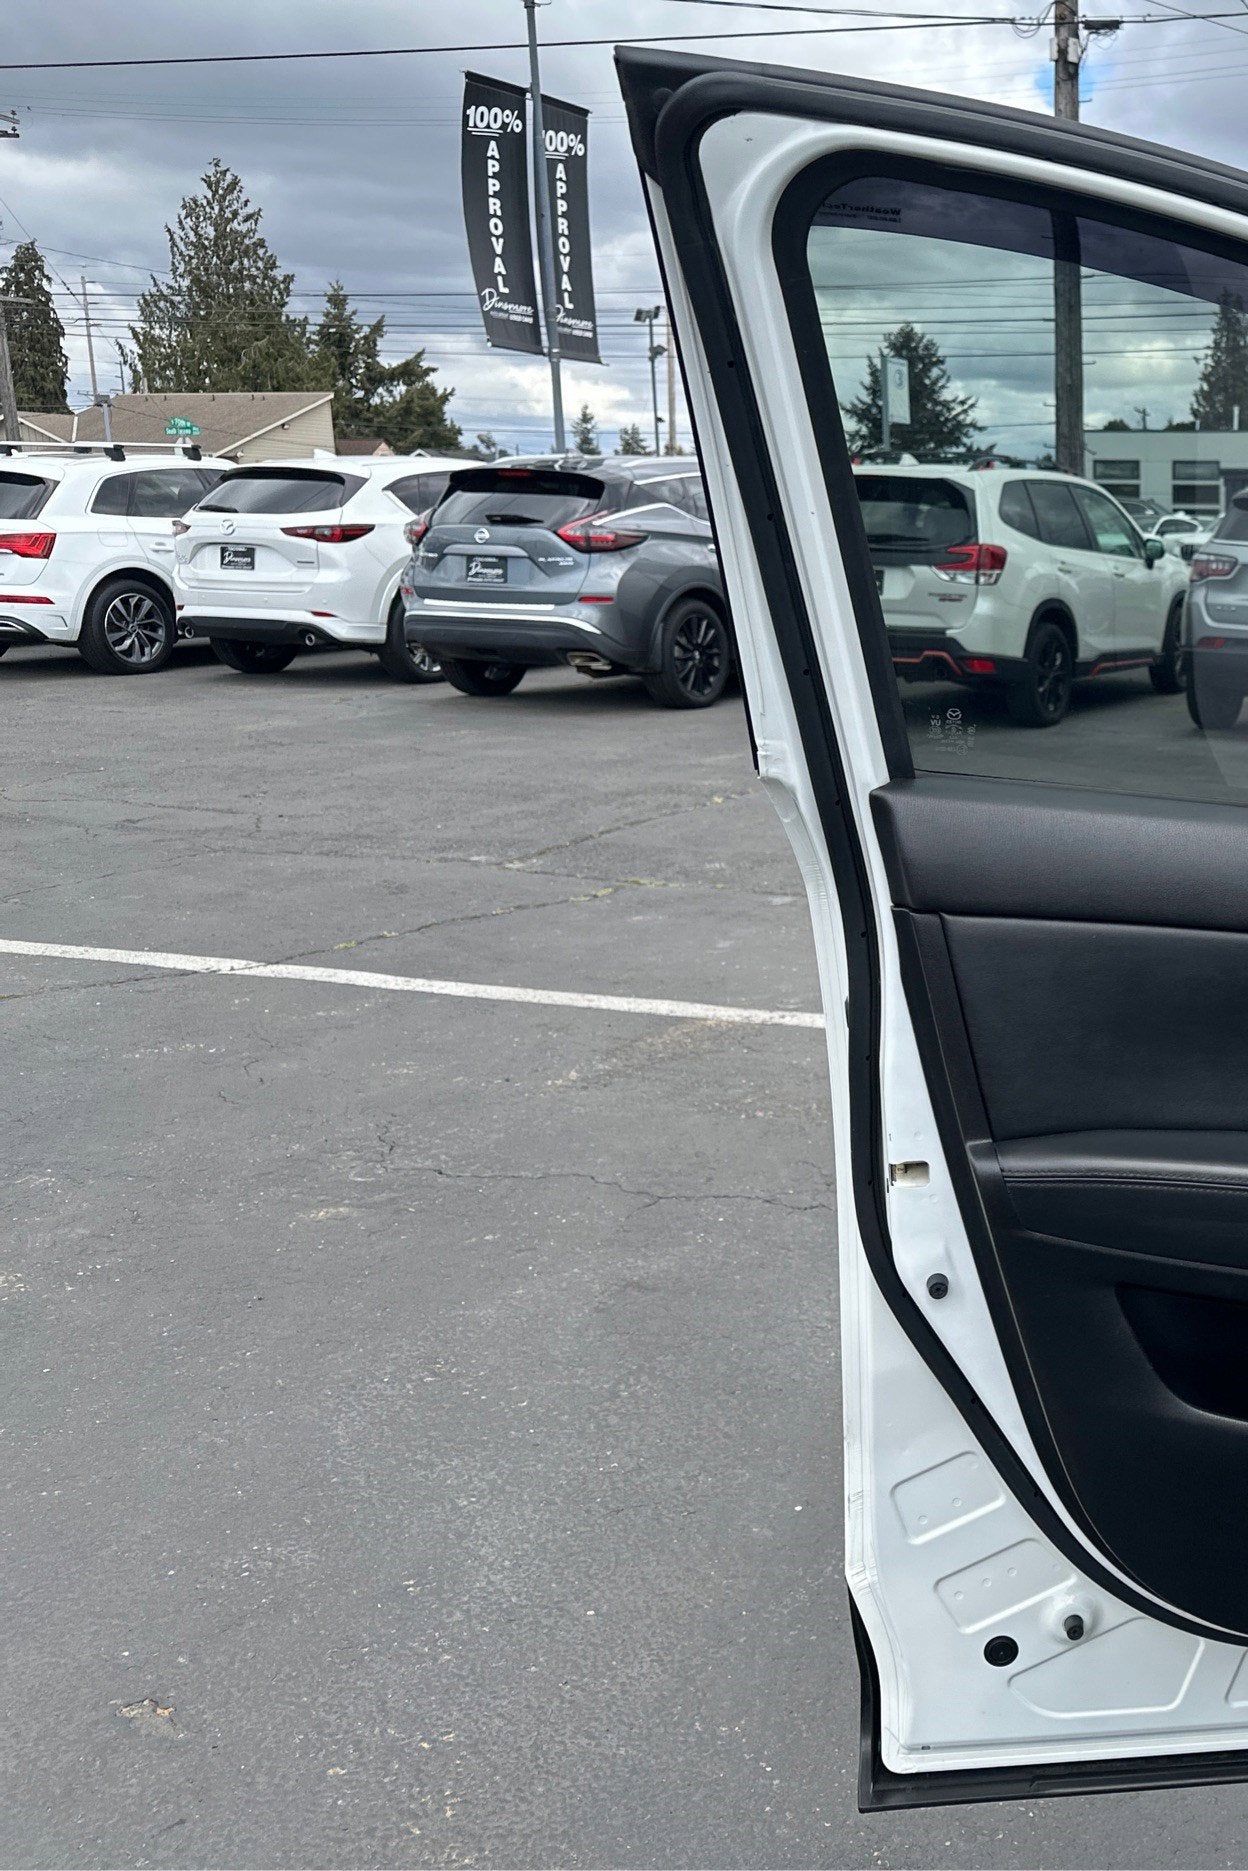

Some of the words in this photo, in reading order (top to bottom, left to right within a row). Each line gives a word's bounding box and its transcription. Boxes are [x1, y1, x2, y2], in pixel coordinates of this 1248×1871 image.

[466, 105, 523, 133] 100%
[486, 140, 509, 293] APPROVAL
[556, 163, 574, 309] APPROVAL
